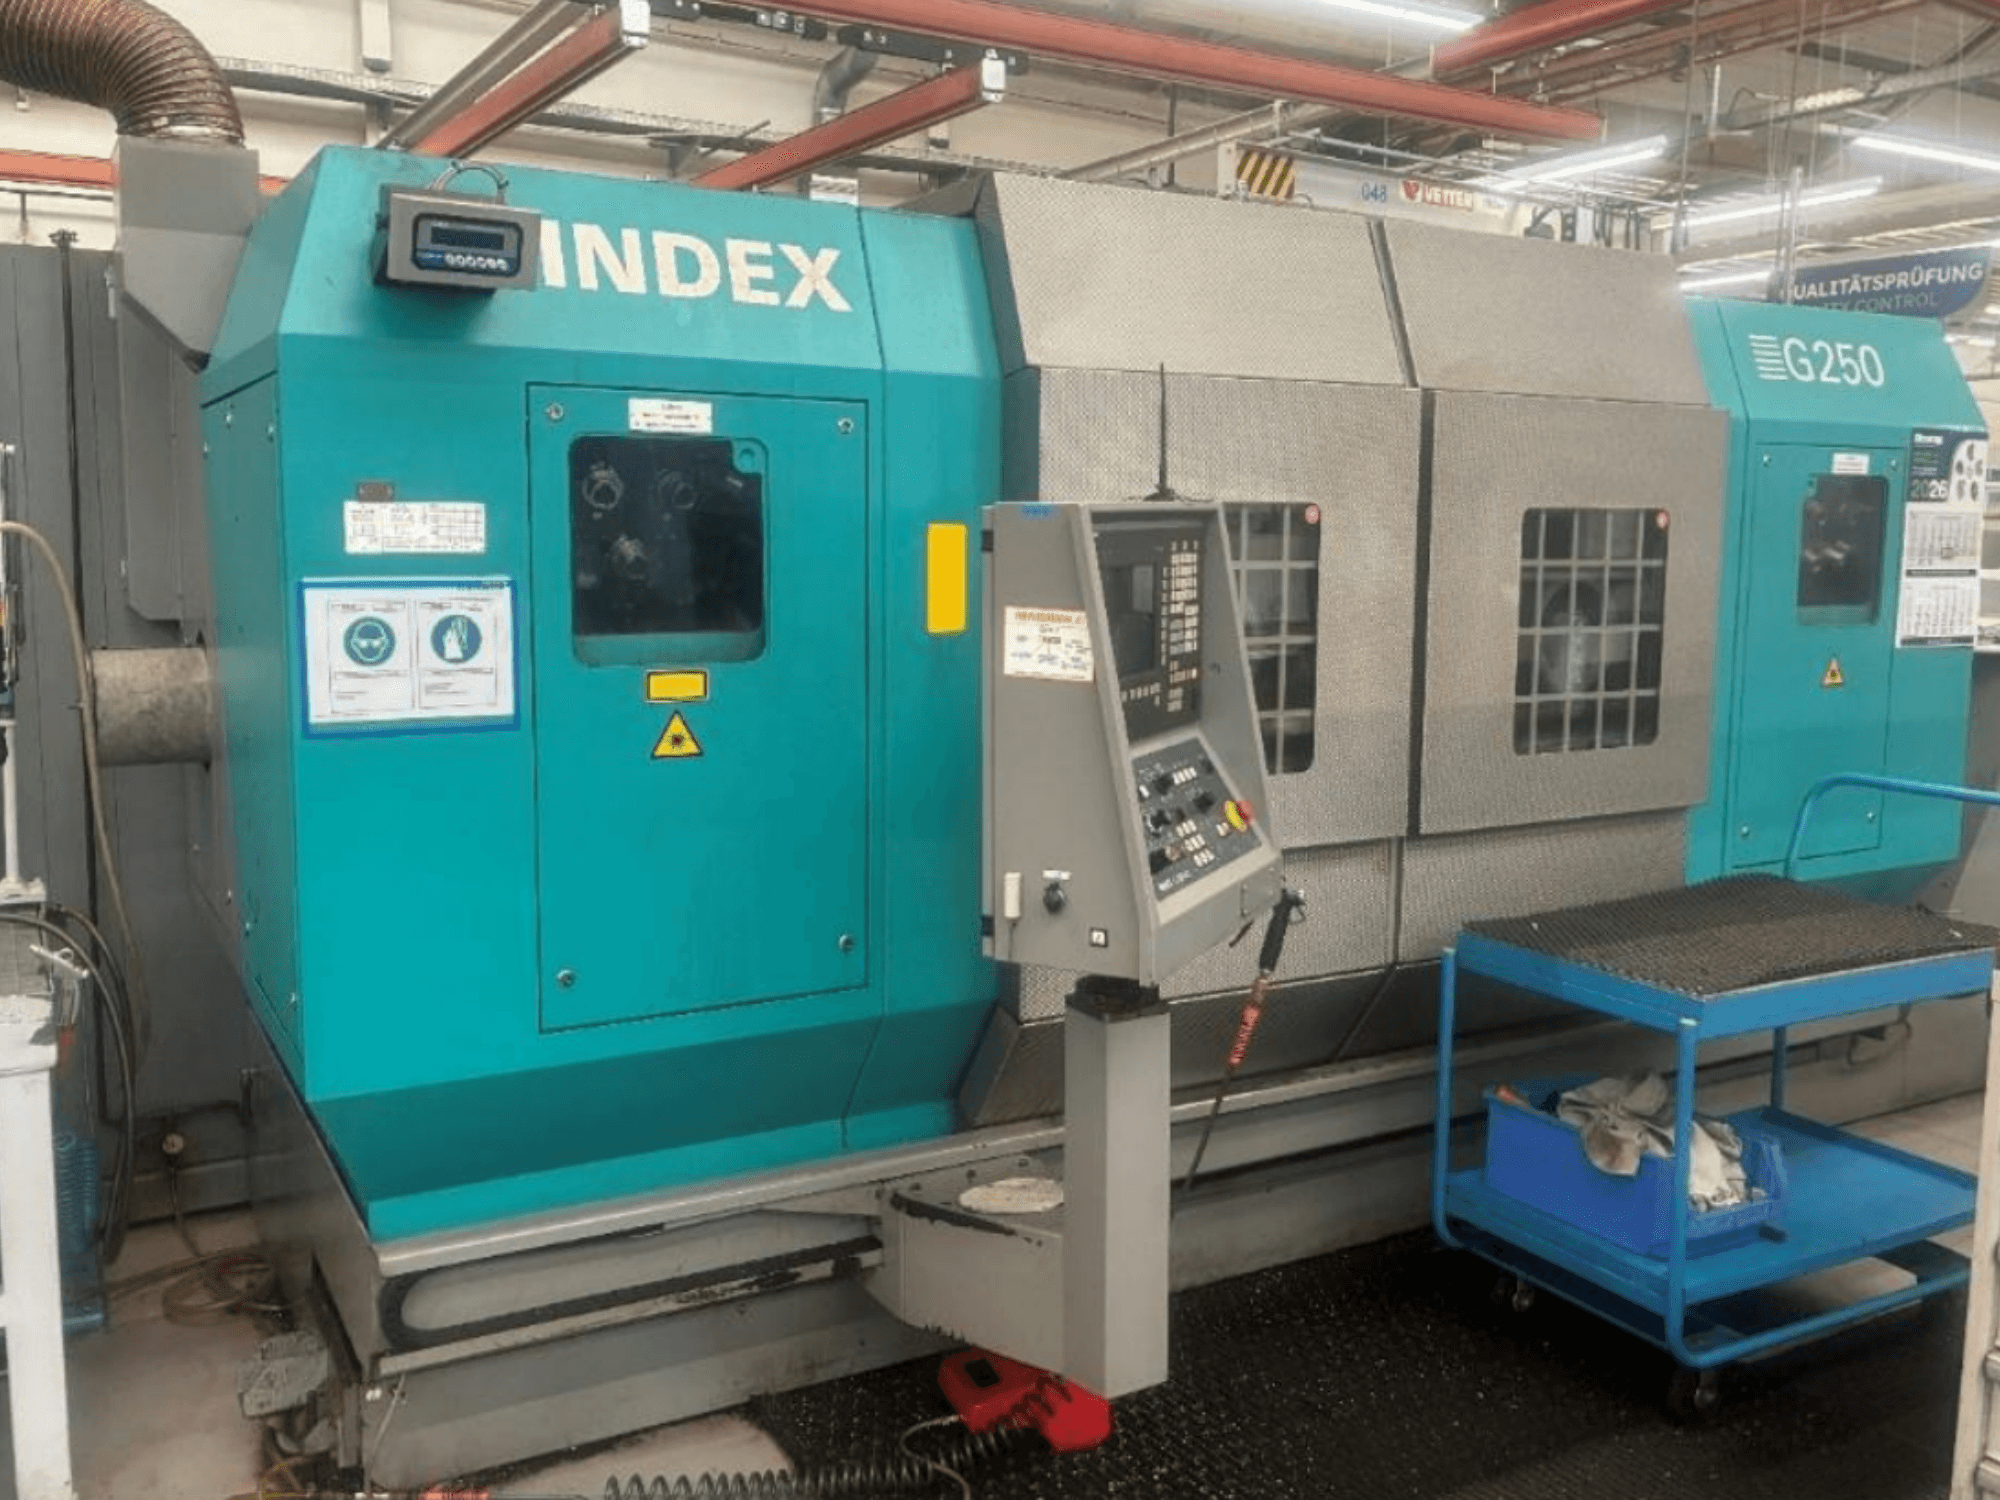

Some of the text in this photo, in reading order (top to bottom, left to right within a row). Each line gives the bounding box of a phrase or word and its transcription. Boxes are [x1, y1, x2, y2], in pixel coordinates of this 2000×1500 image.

[541, 219, 853, 312] INDEX
[1781, 262, 1984, 300] UALITÄTSPRÜFUNG
[1783, 337, 1885, 388] G250
